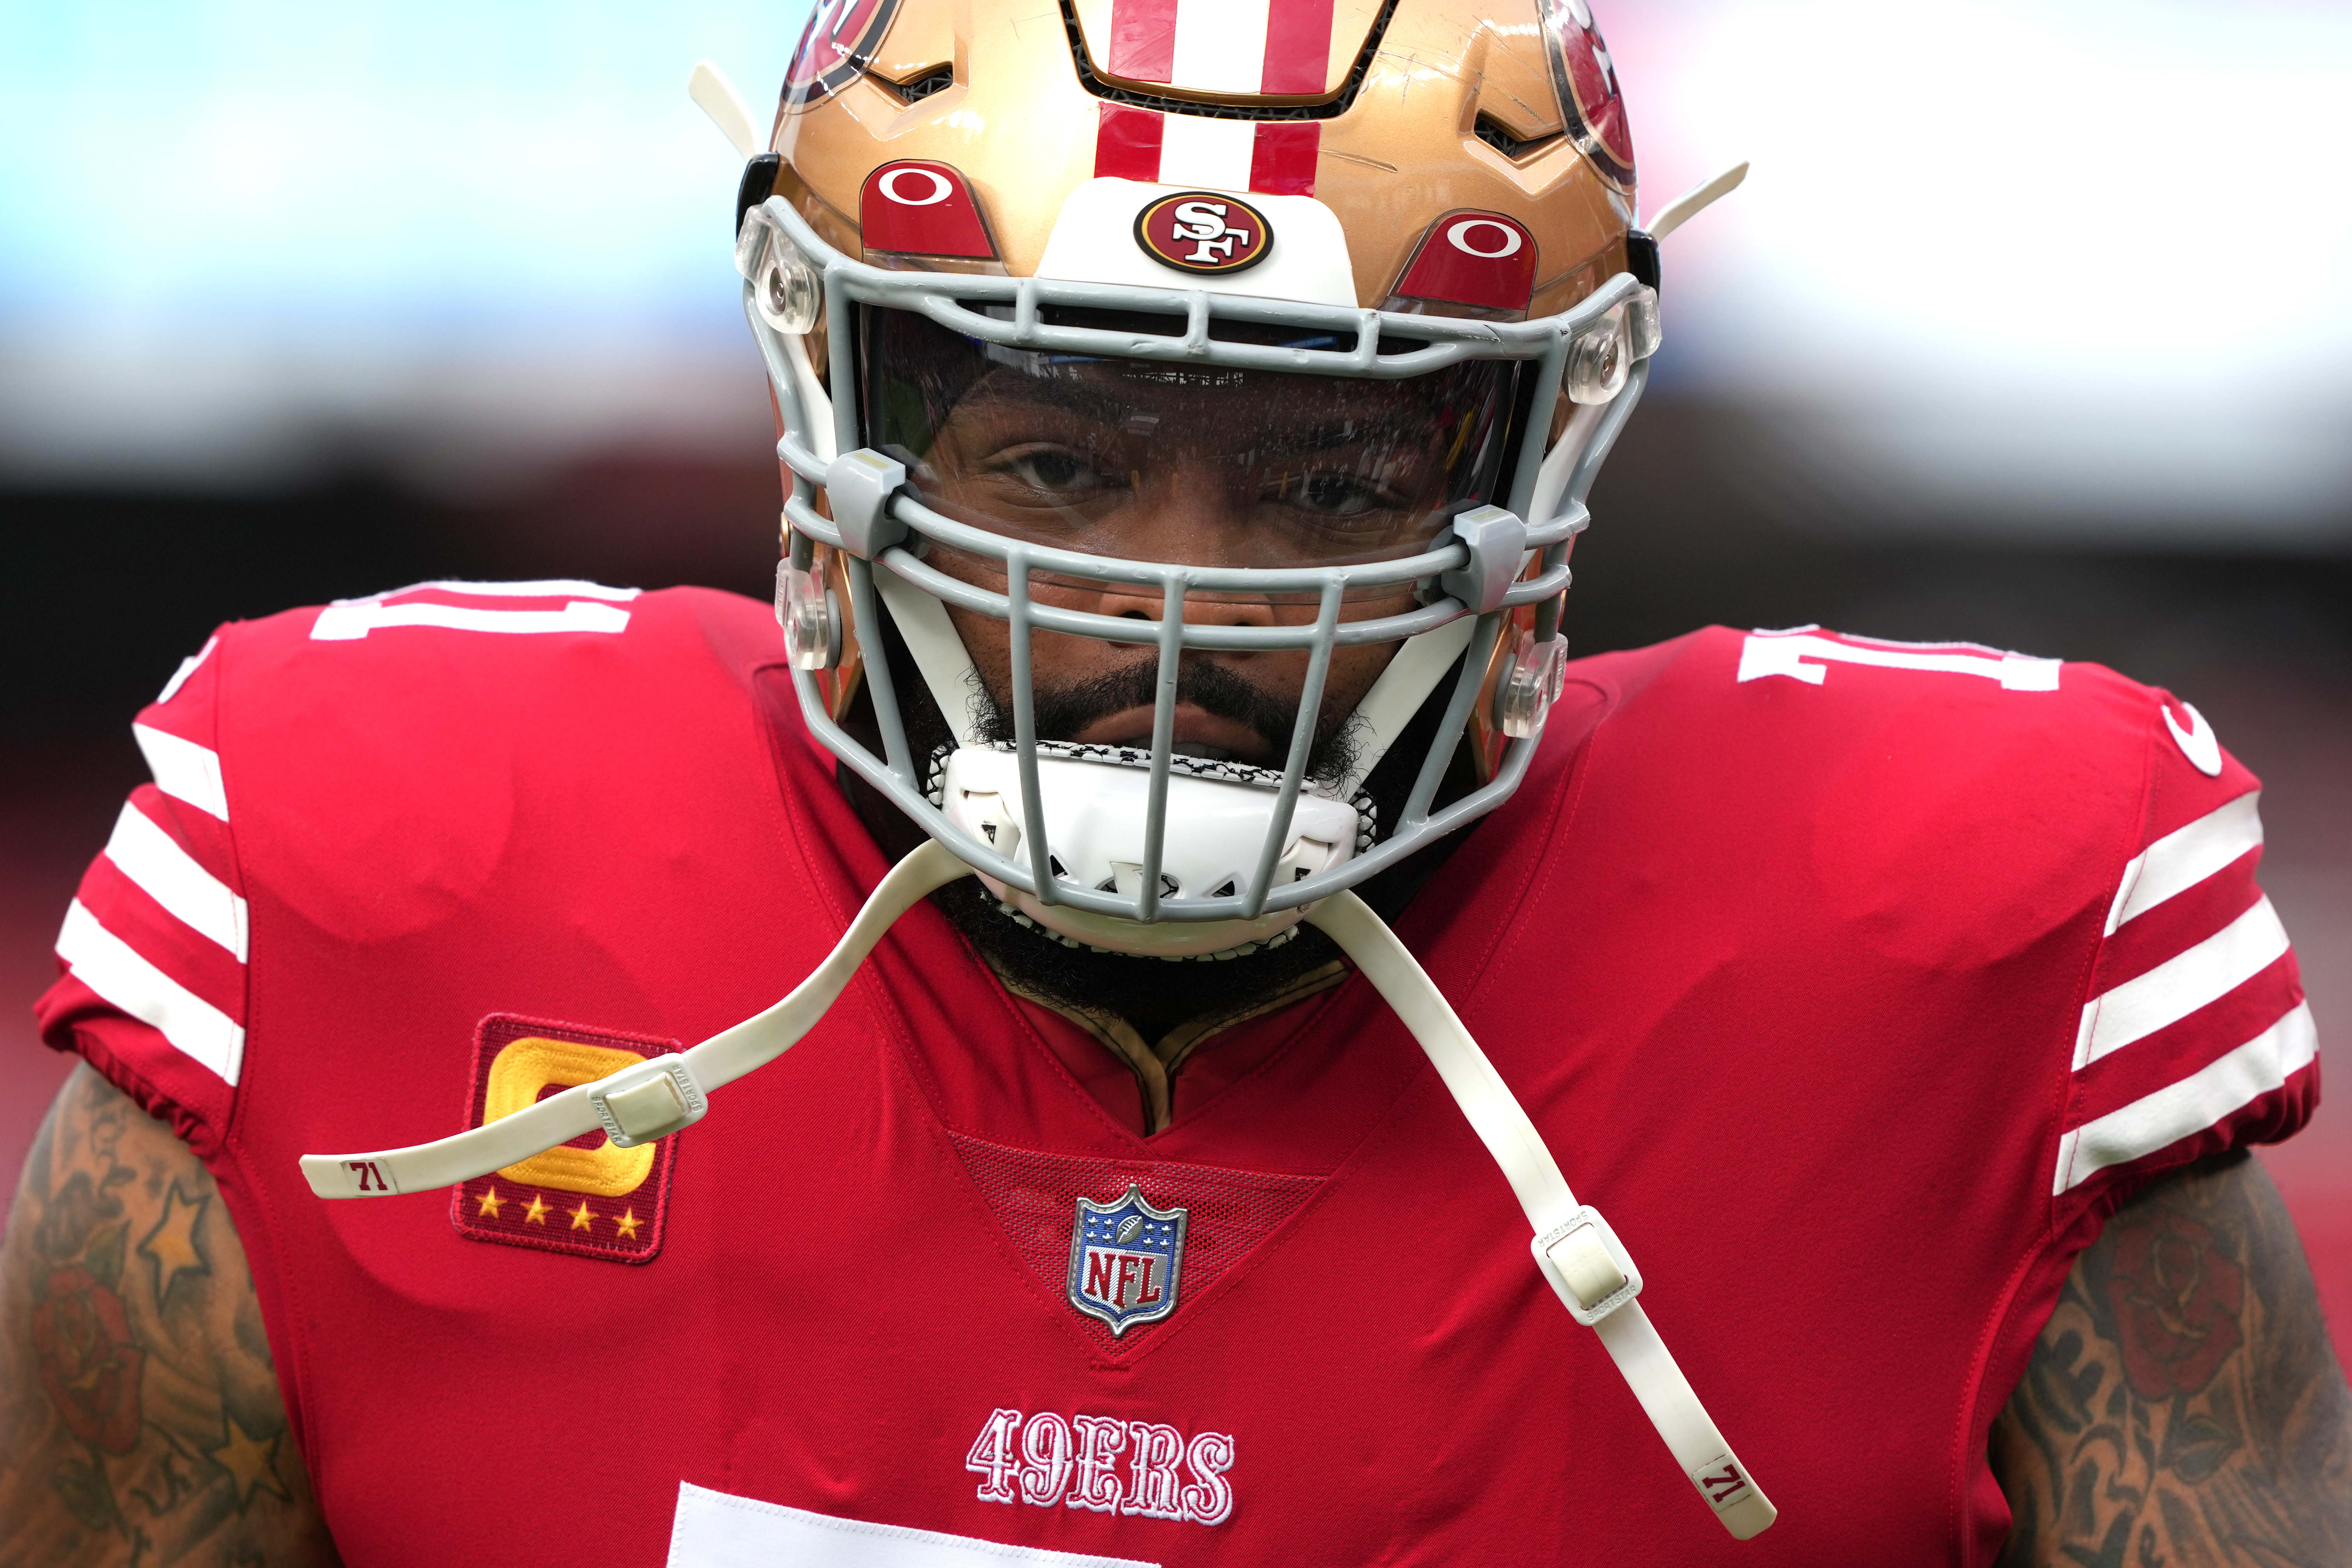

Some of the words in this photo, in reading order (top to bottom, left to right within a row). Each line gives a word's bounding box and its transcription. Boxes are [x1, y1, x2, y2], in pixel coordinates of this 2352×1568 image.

[1172, 201, 1250, 264] SF
[672, 1063, 702, 1111] SPORTSTAR
[592, 1096, 623, 1143] SPORTSTAR
[349, 1162, 388, 1191] 71
[1537, 1210, 1588, 1247] SPORTSTAR
[1084, 1250, 1163, 1309] NFL
[1586, 1285, 1636, 1321] SPORTSTAR
[966, 1407, 1235, 1527] 49ERS
[1702, 1464, 1746, 1503] 71
